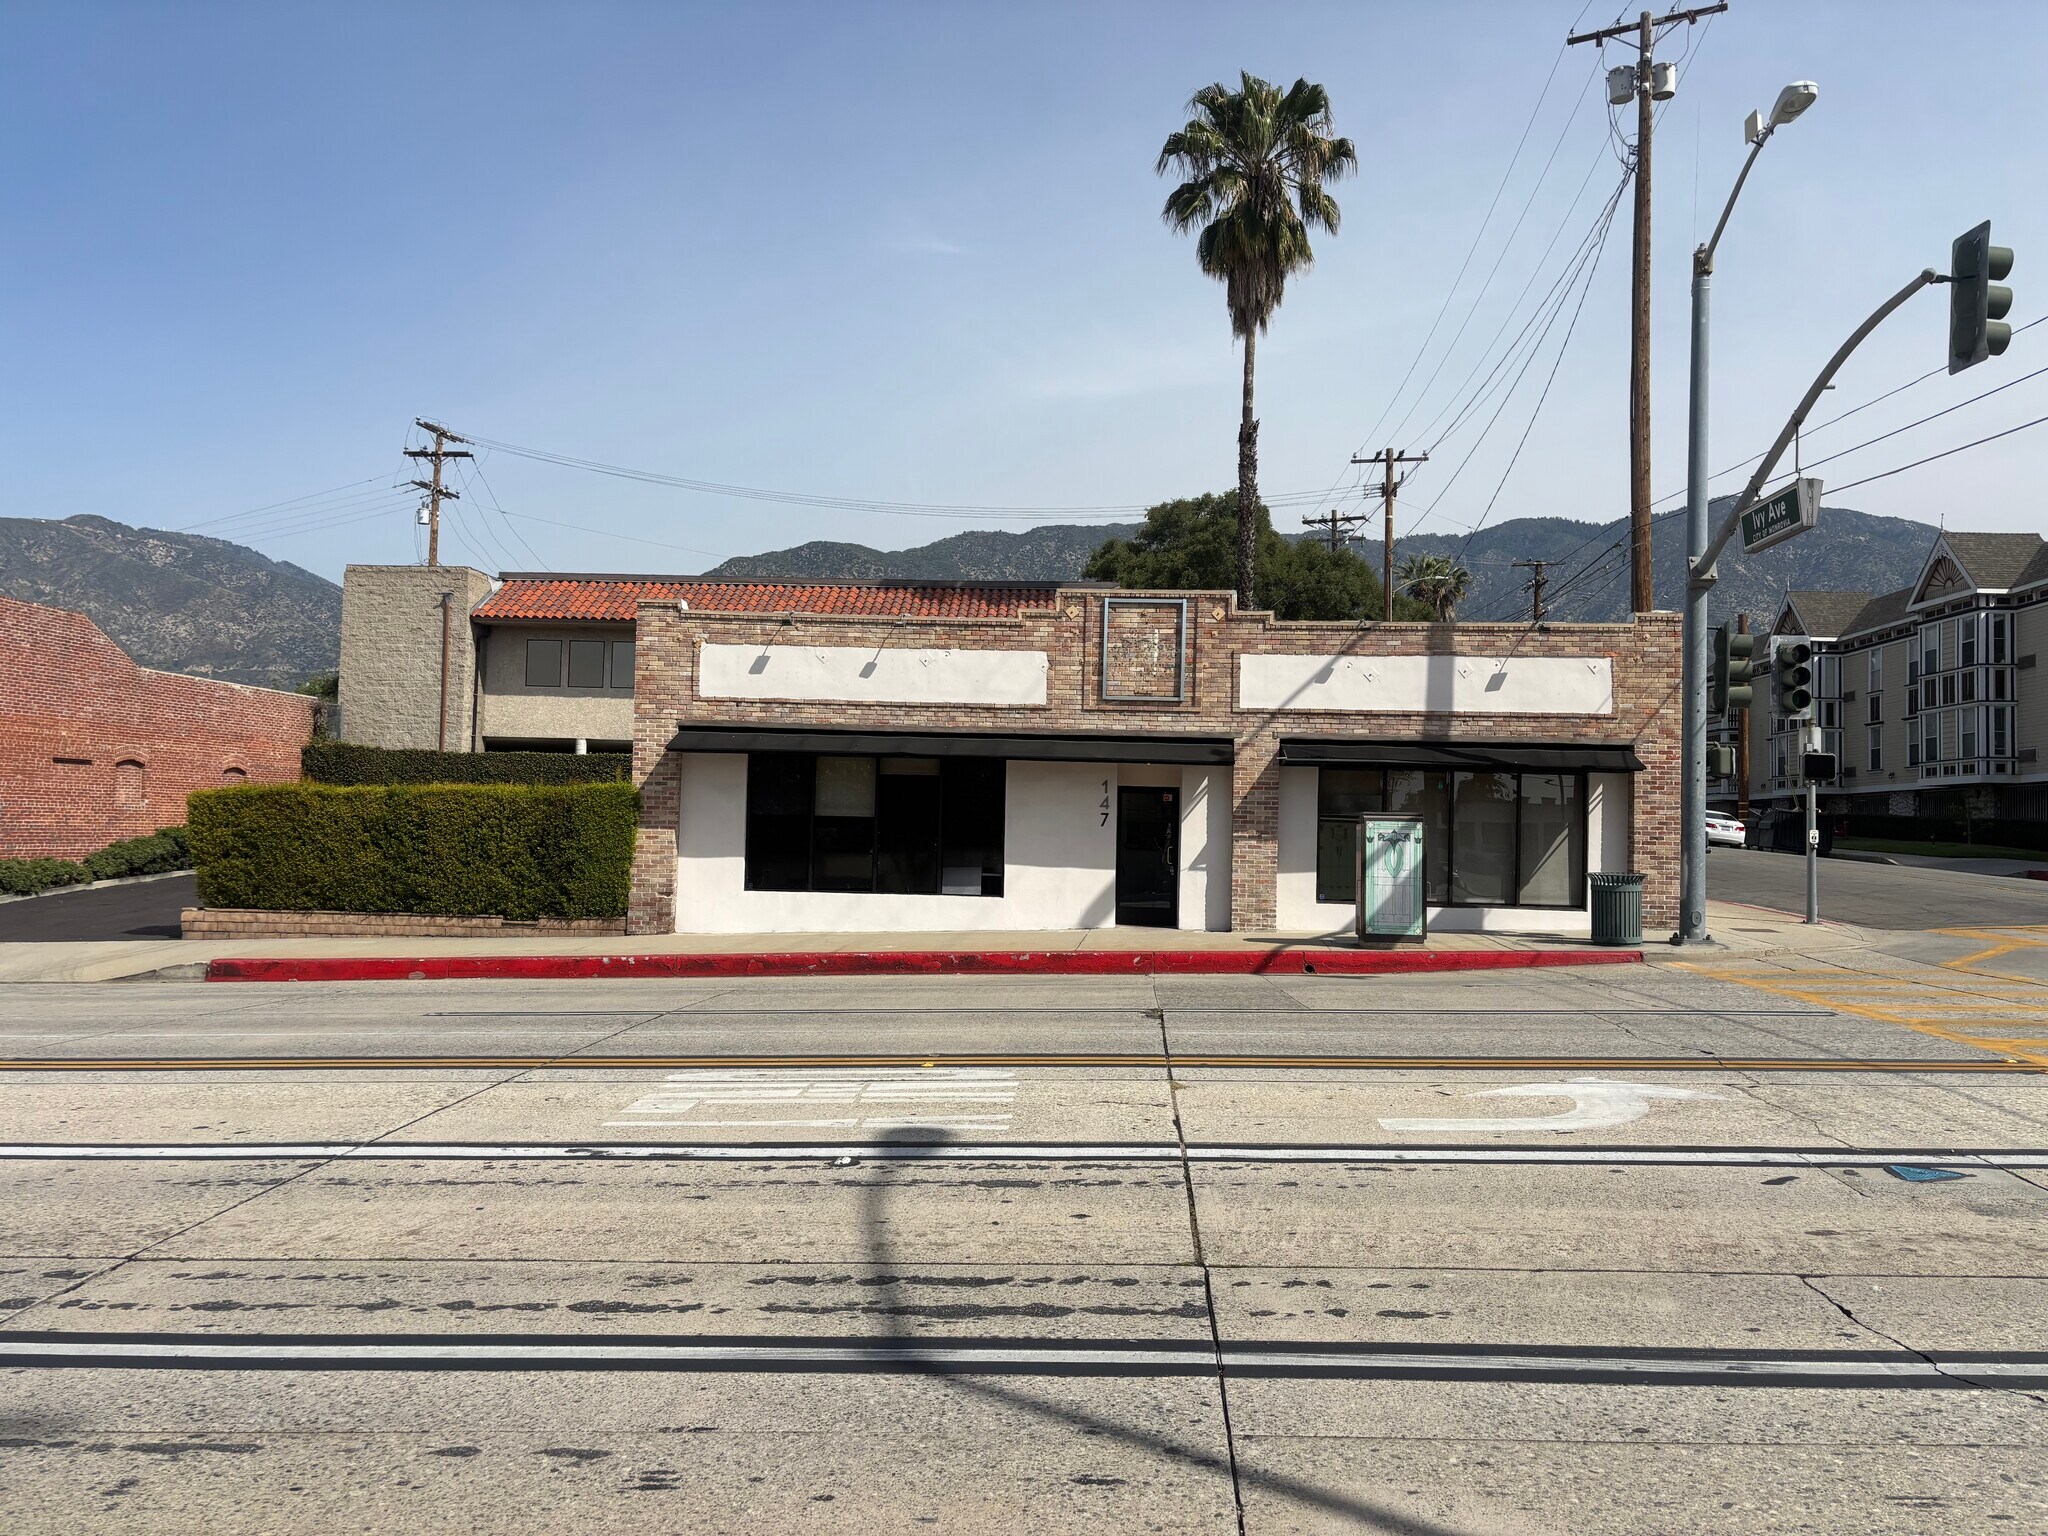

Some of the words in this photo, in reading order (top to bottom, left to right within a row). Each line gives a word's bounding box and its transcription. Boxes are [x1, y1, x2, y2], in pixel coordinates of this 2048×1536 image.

[1752, 511, 1765, 530] Ivy
[1768, 501, 1786, 522] Ave
[1753, 531, 1762, 542] CITY
[1762, 528, 1768, 537] OF
[1768, 518, 1791, 534] MONROVIA
[1099, 779, 1110, 827] 147
[600, 1069, 1020, 1130] ONLY
